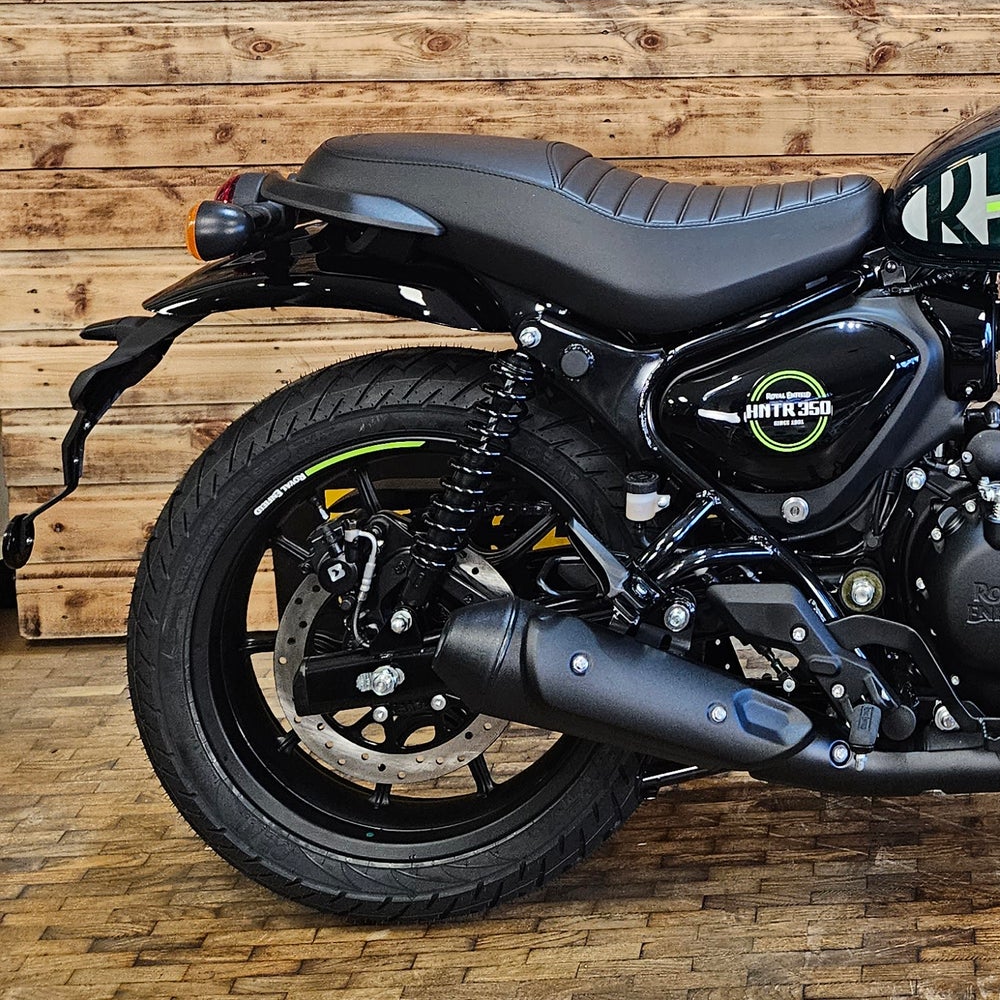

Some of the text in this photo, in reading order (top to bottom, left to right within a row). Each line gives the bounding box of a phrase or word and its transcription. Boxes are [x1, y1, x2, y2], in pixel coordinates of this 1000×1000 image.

[746, 401, 831, 418] HNTR 350
[283, 473, 306, 491] ROYAL
